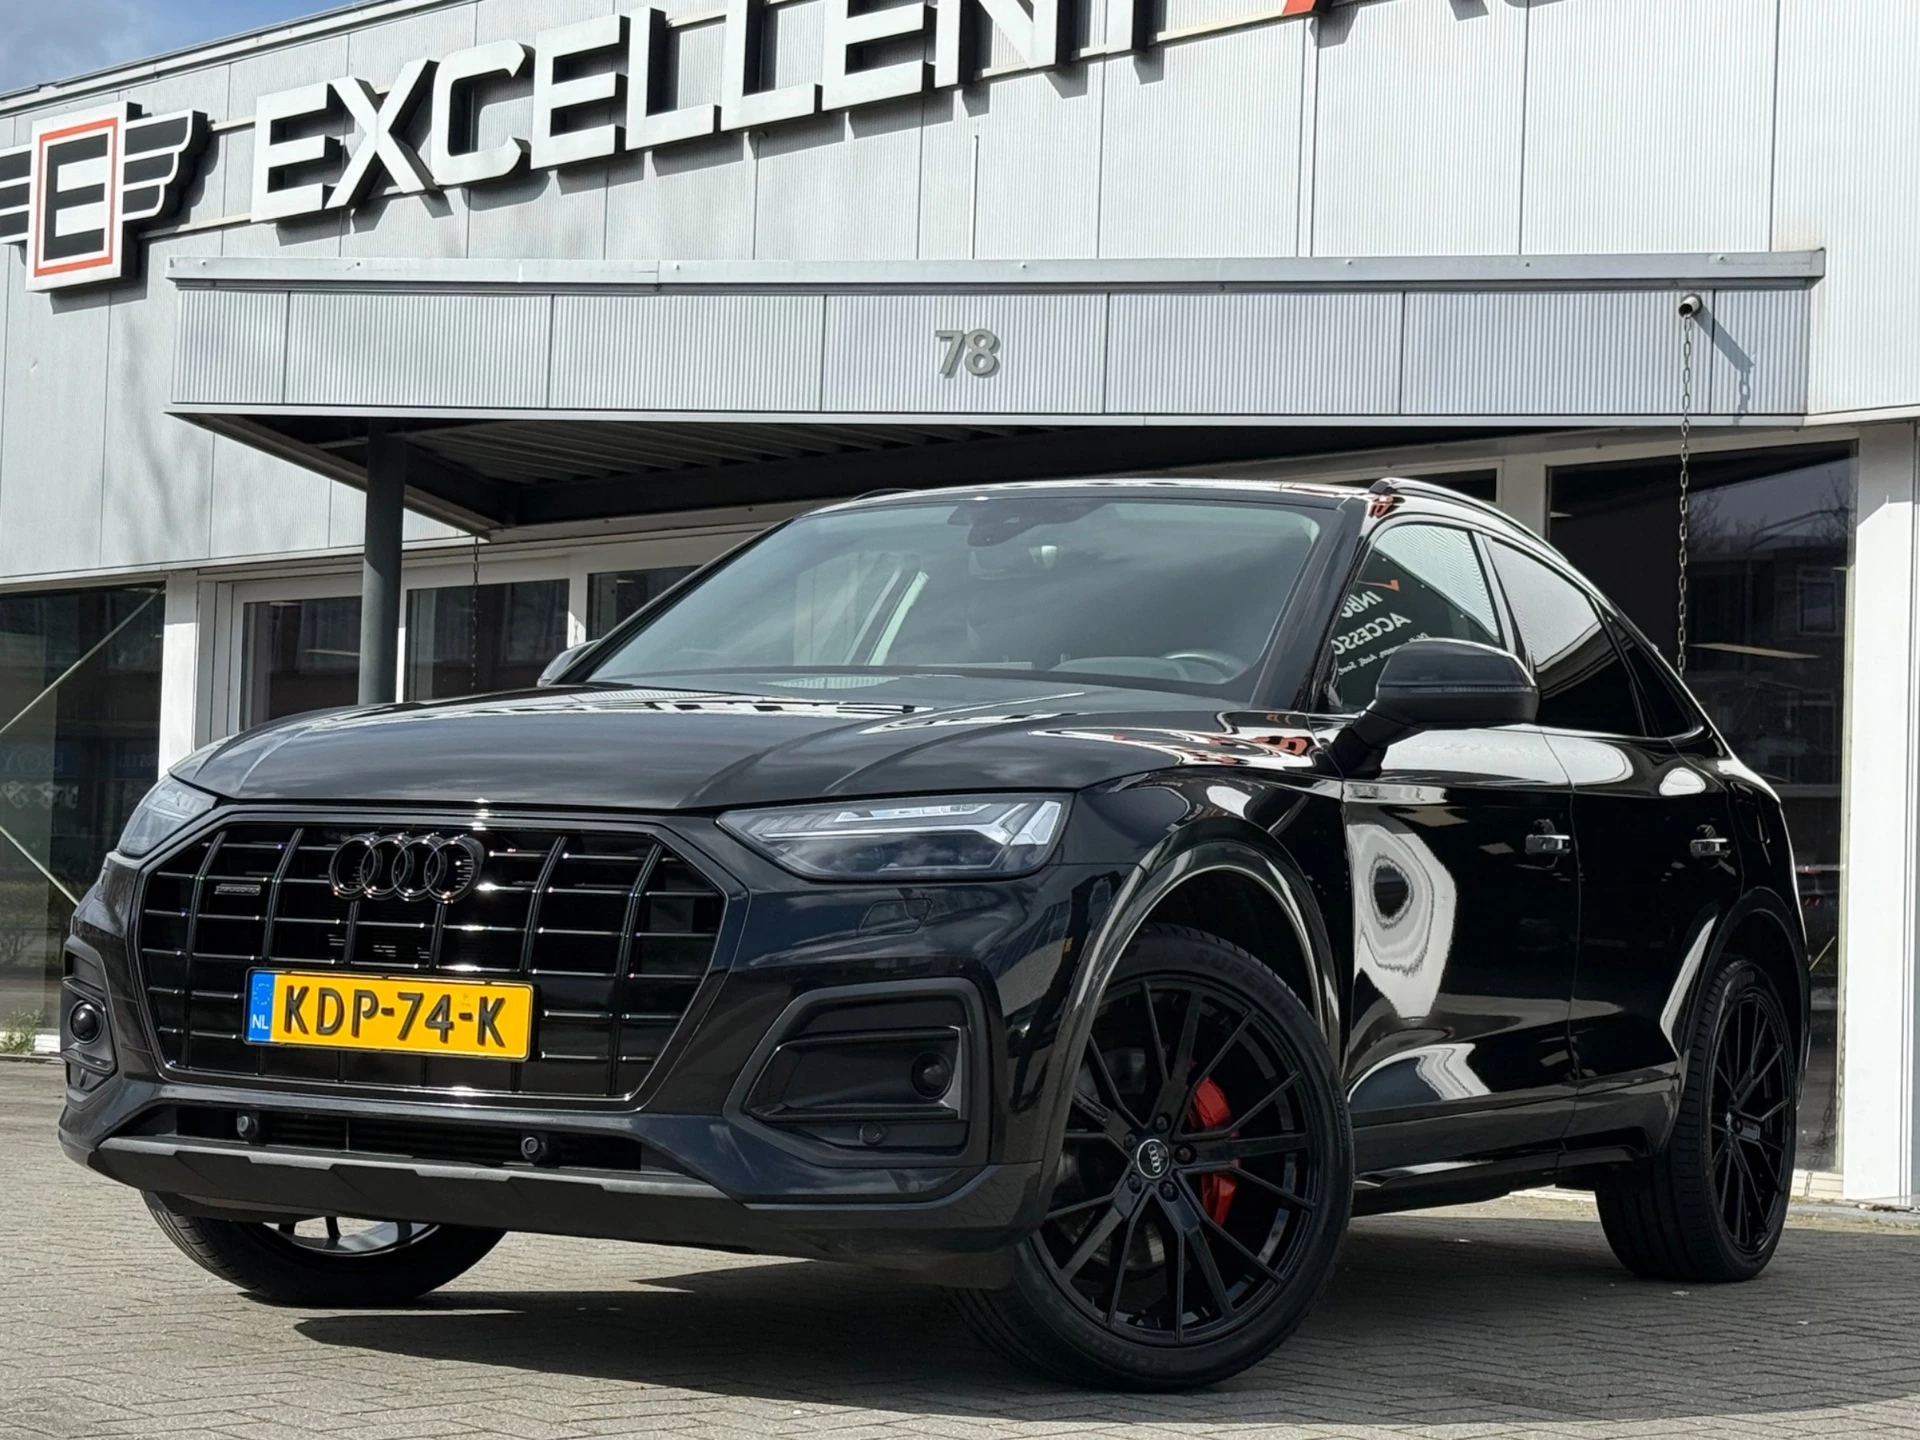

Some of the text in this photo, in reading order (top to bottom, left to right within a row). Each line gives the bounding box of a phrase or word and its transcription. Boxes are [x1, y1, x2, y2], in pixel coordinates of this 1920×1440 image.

[935, 328, 1000, 378] 78
[252, 1013, 269, 1030] NL
[284, 984, 507, 1048] KDP-74-K
